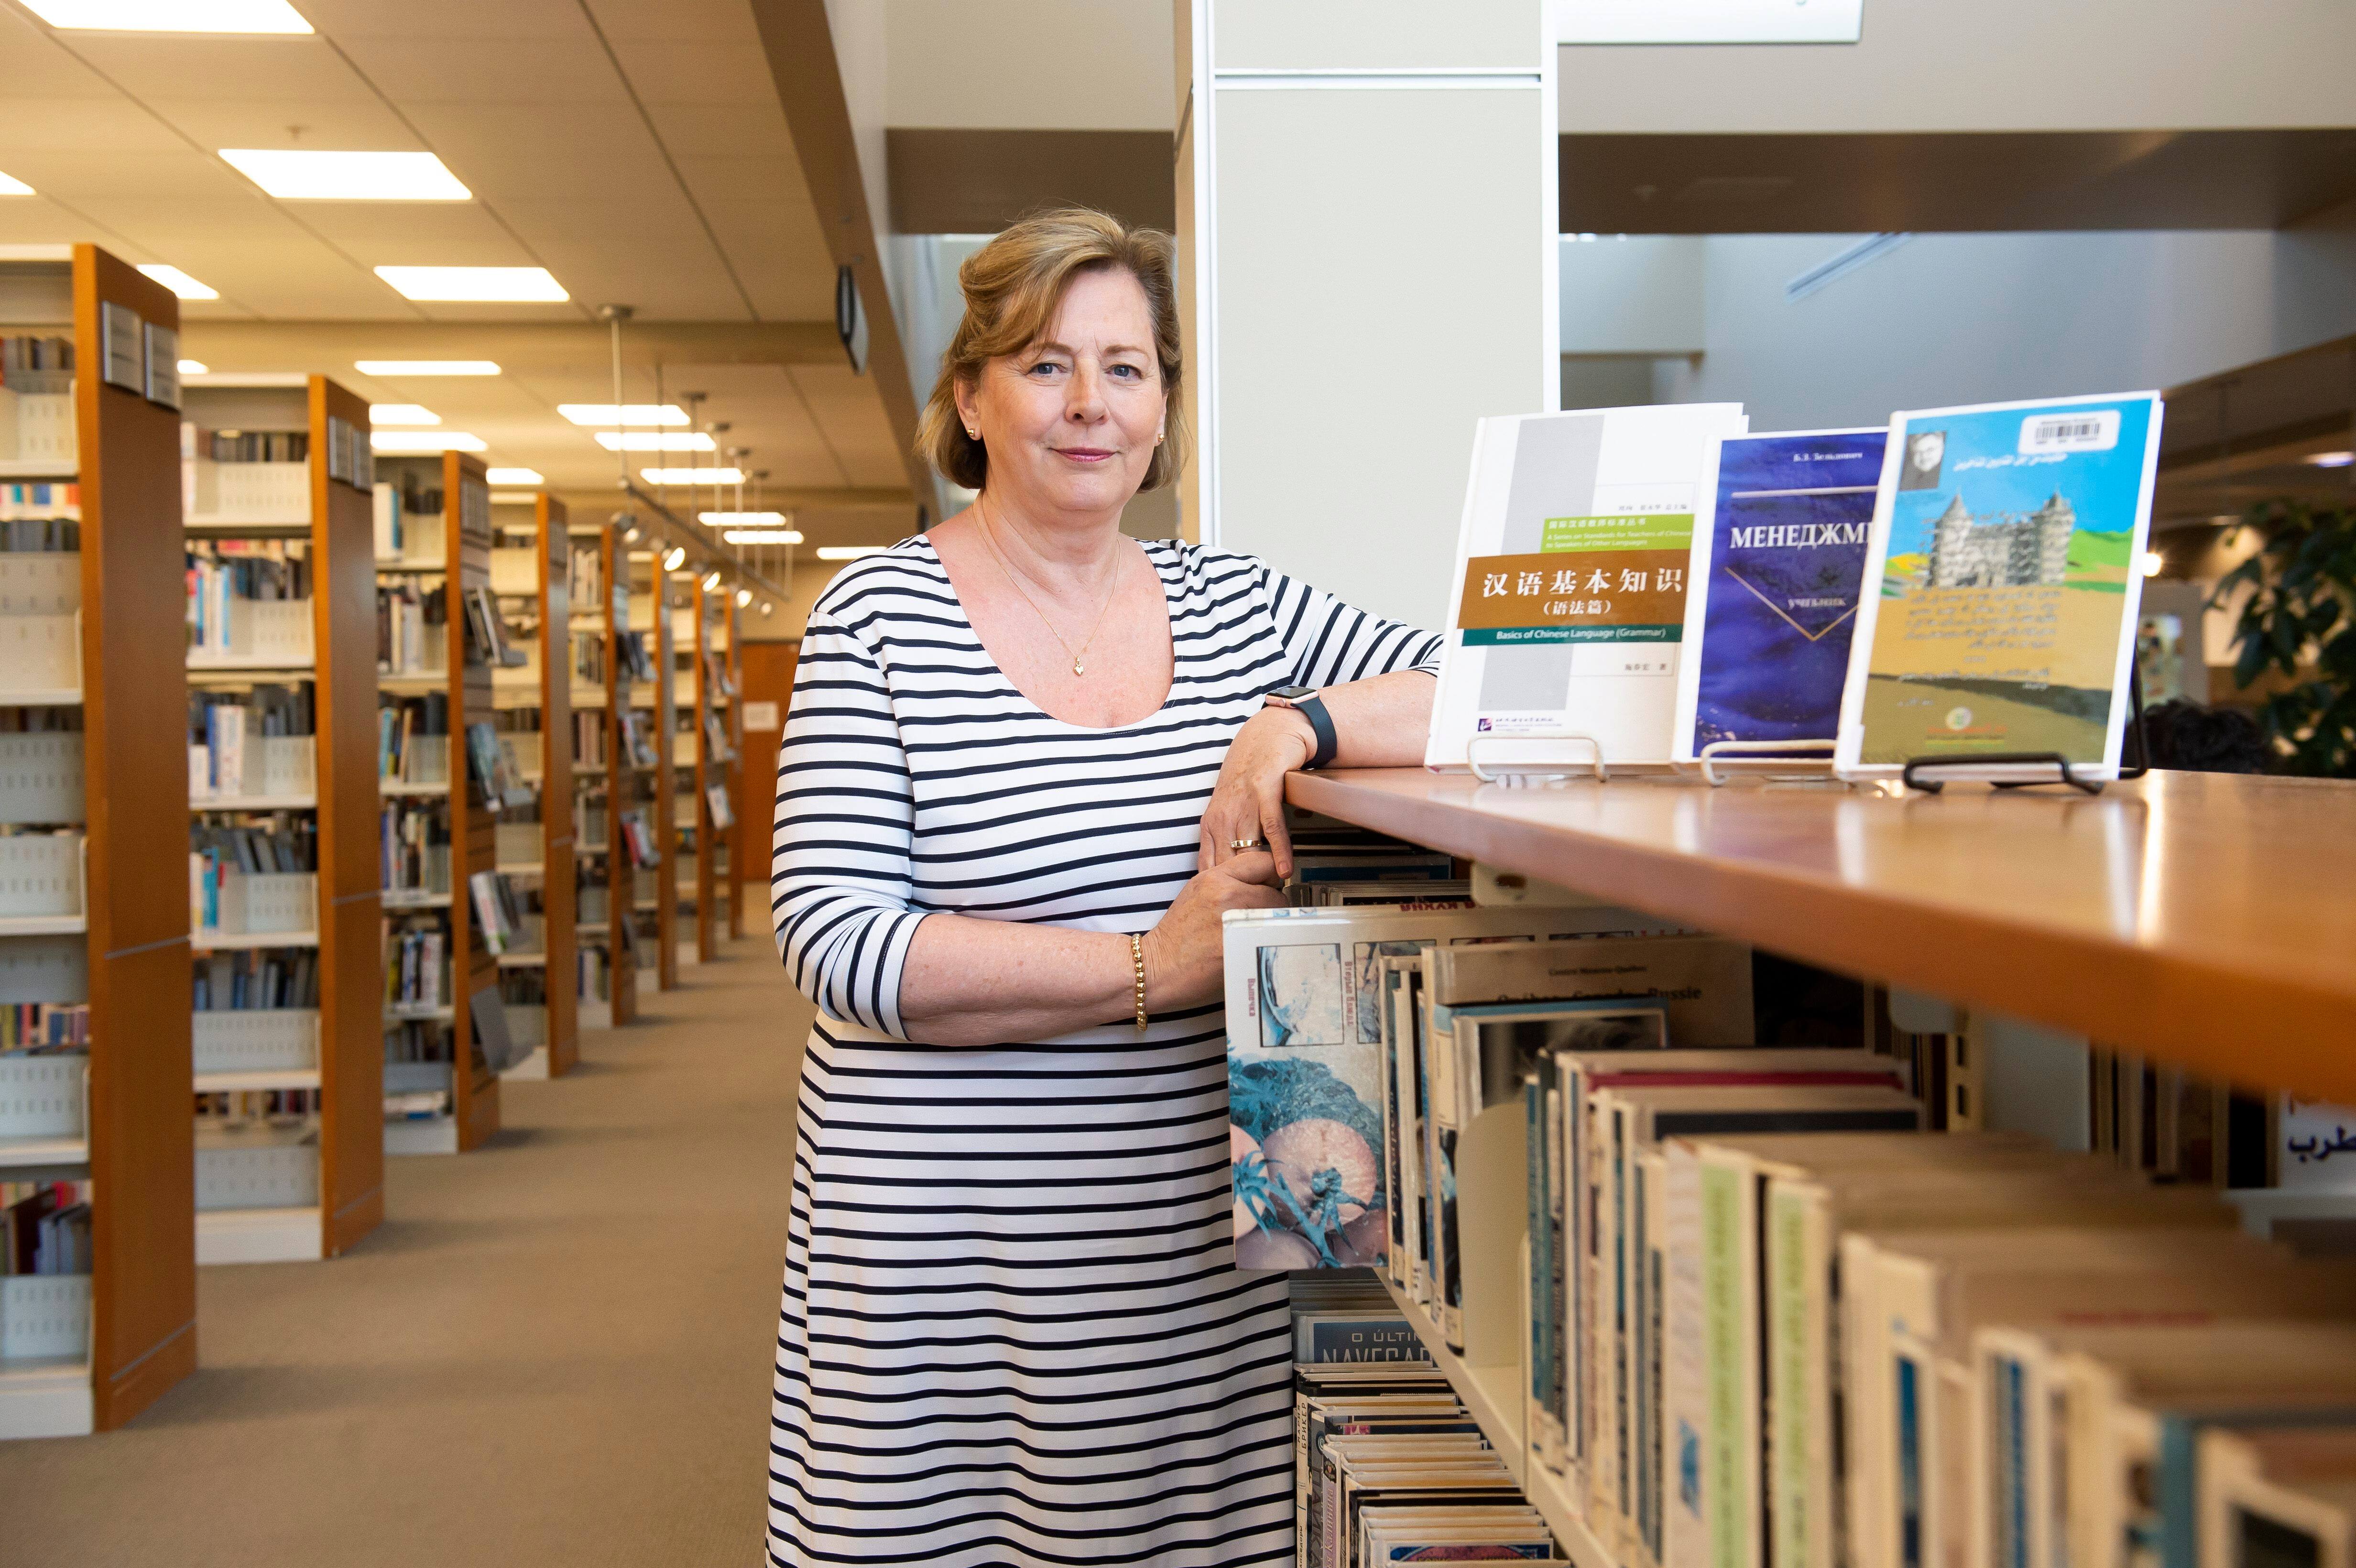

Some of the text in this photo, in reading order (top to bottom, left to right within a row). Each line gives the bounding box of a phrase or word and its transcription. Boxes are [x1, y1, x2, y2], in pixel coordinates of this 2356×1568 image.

[1483, 568, 1682, 598] 汉语基本知识
[1496, 628, 1666, 640] Basics of Chinese Language (Grammar)
[1352, 1333, 1363, 1342] O
[1325, 1489, 1333, 1552] Калинина
